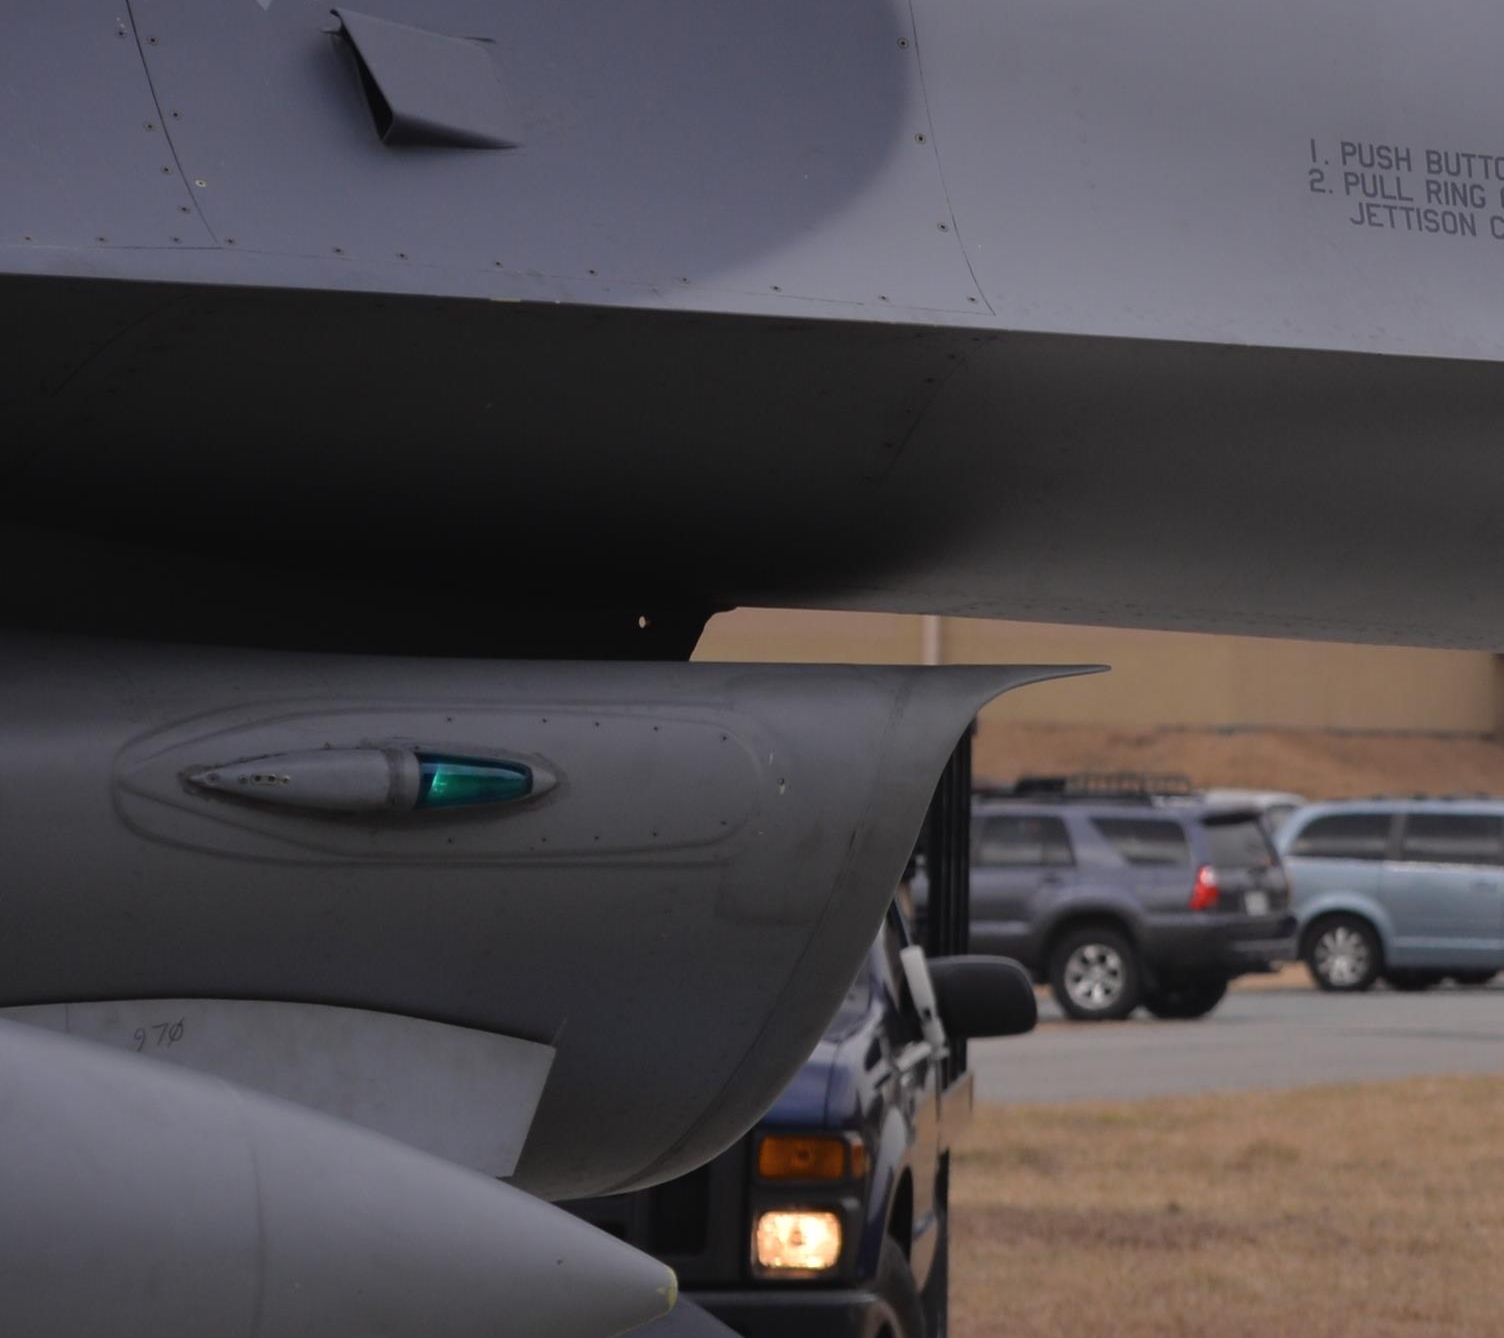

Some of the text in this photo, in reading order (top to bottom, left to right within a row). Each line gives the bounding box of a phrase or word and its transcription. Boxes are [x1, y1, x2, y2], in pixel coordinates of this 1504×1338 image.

[1340, 141, 1413, 173] PUSH
[1308, 168, 1334, 195] 2.
[1343, 171, 1414, 202] PULL
[1425, 179, 1487, 210] RING
[1350, 202, 1477, 237] JETTISON
